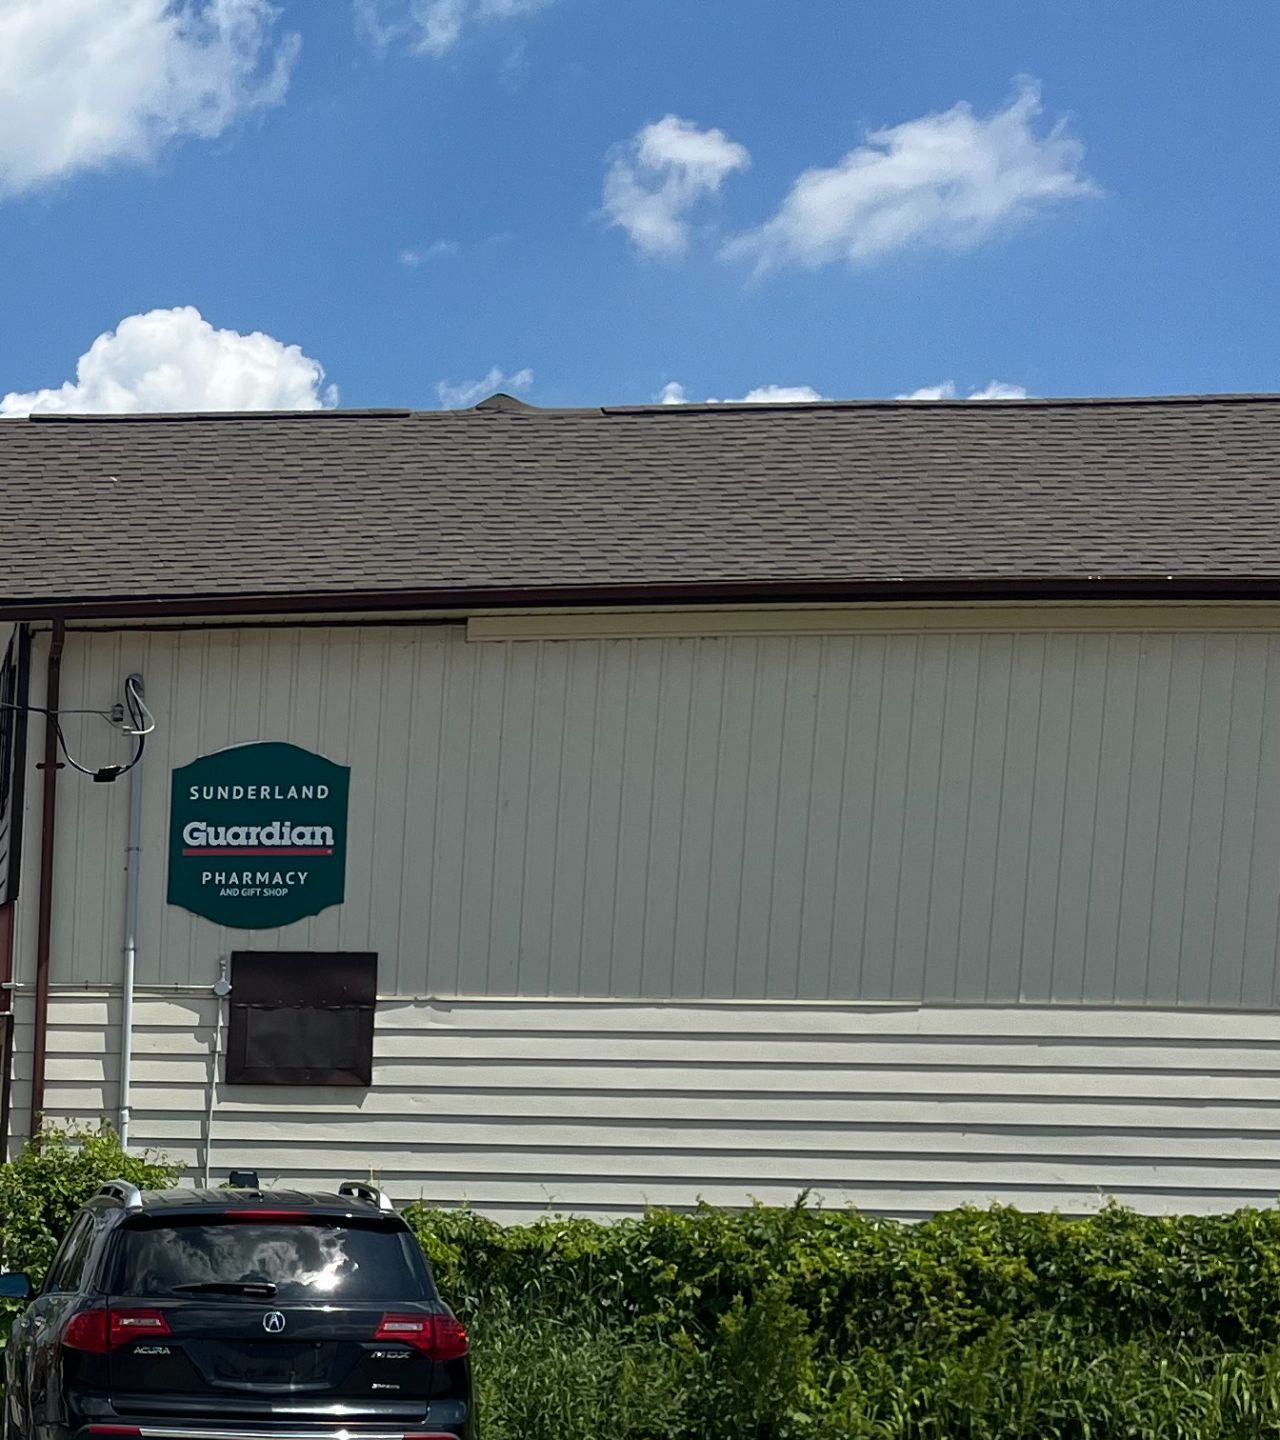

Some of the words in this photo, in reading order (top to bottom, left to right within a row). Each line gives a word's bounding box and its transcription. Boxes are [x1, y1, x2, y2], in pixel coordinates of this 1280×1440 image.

[190, 785, 329, 800] SUNDERLAND
[182, 821, 334, 846] Guardian
[202, 872, 309, 885] PHARMACY
[219, 888, 239, 897] AND
[241, 888, 261, 897] GIFT
[263, 888, 288, 897] SHOP
[133, 1346, 171, 1355] ACURA
